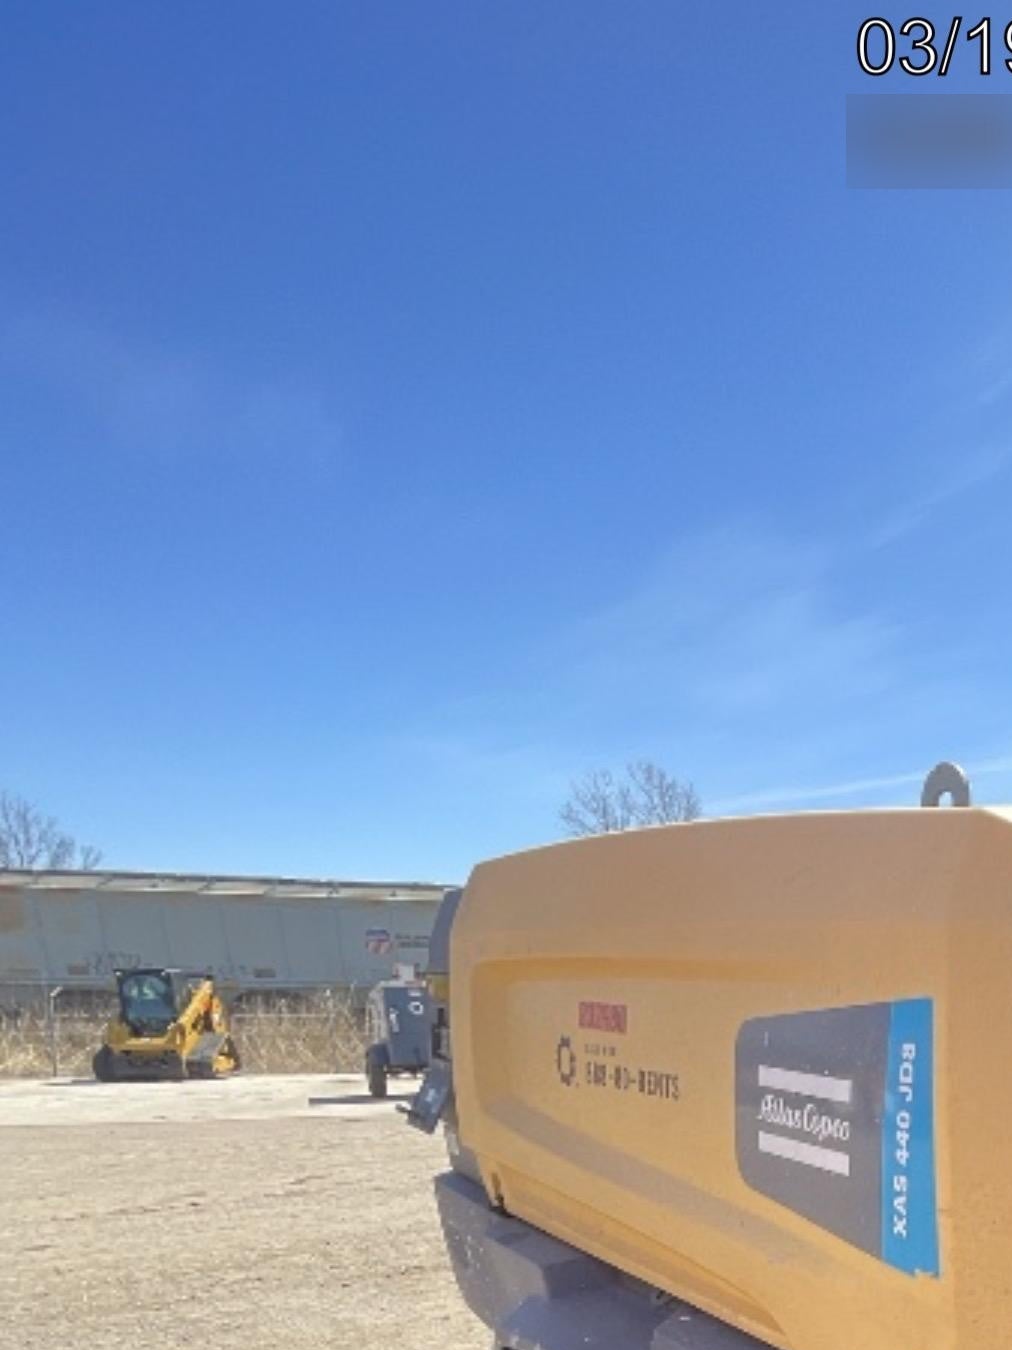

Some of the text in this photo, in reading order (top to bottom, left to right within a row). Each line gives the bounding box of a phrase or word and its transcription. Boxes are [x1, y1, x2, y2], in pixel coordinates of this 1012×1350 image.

[756, 1094, 850, 1140] Atlas Copco
[892, 1042, 916, 1239] XAS 440 JD8
